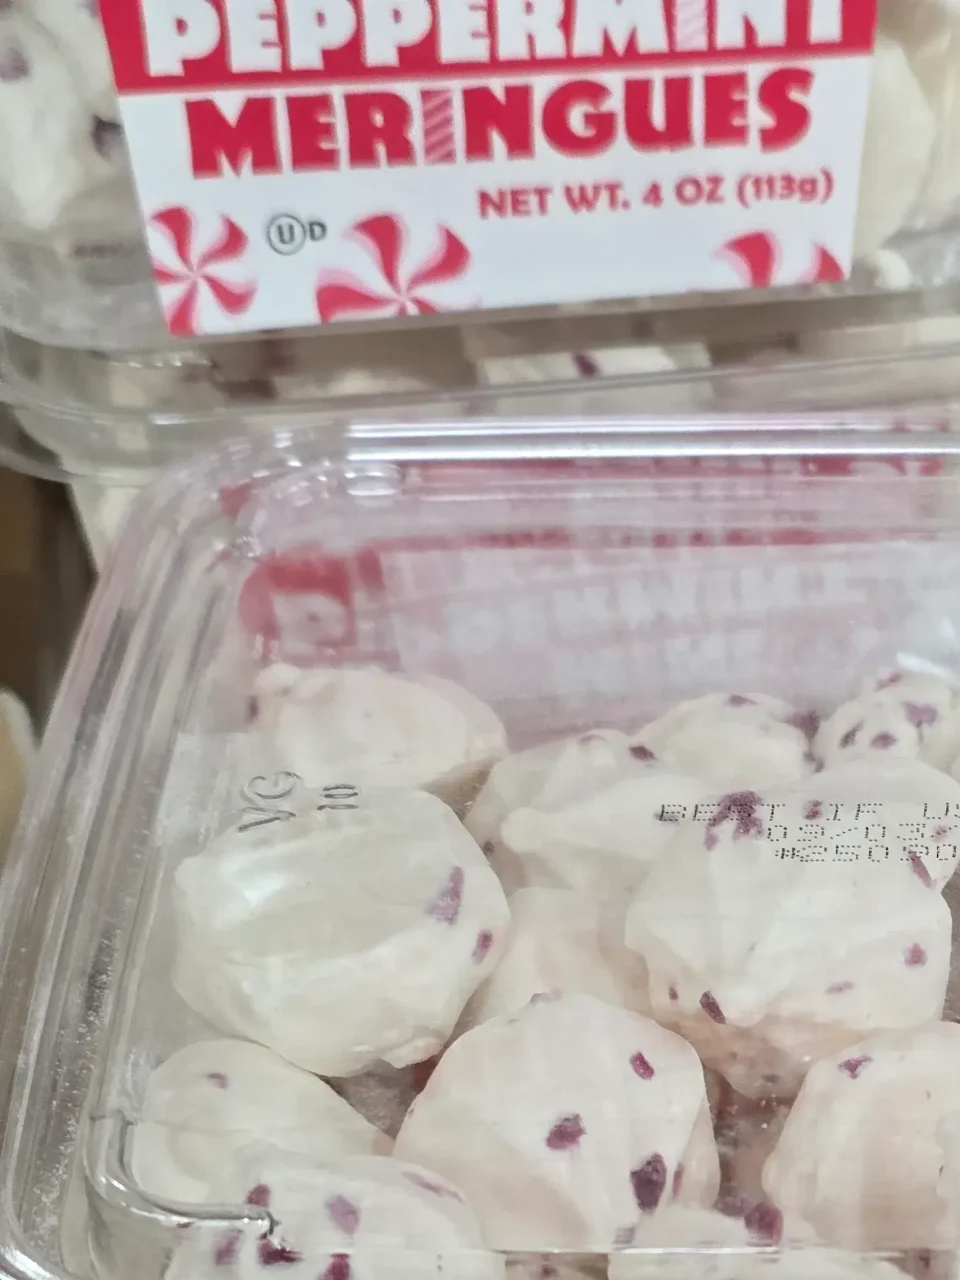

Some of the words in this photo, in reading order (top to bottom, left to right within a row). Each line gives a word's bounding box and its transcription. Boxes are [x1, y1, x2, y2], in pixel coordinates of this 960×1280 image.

[184, 67, 815, 181] MERINGUES
[477, 184, 552, 220] NET
[563, 179, 632, 214] WT.
[641, 180, 665, 208] 4
[674, 173, 726, 207] OZ
[736, 167, 836, 209] (113g)
[657, 802, 787, 822] BEST
[825, 802, 883, 822] IF
